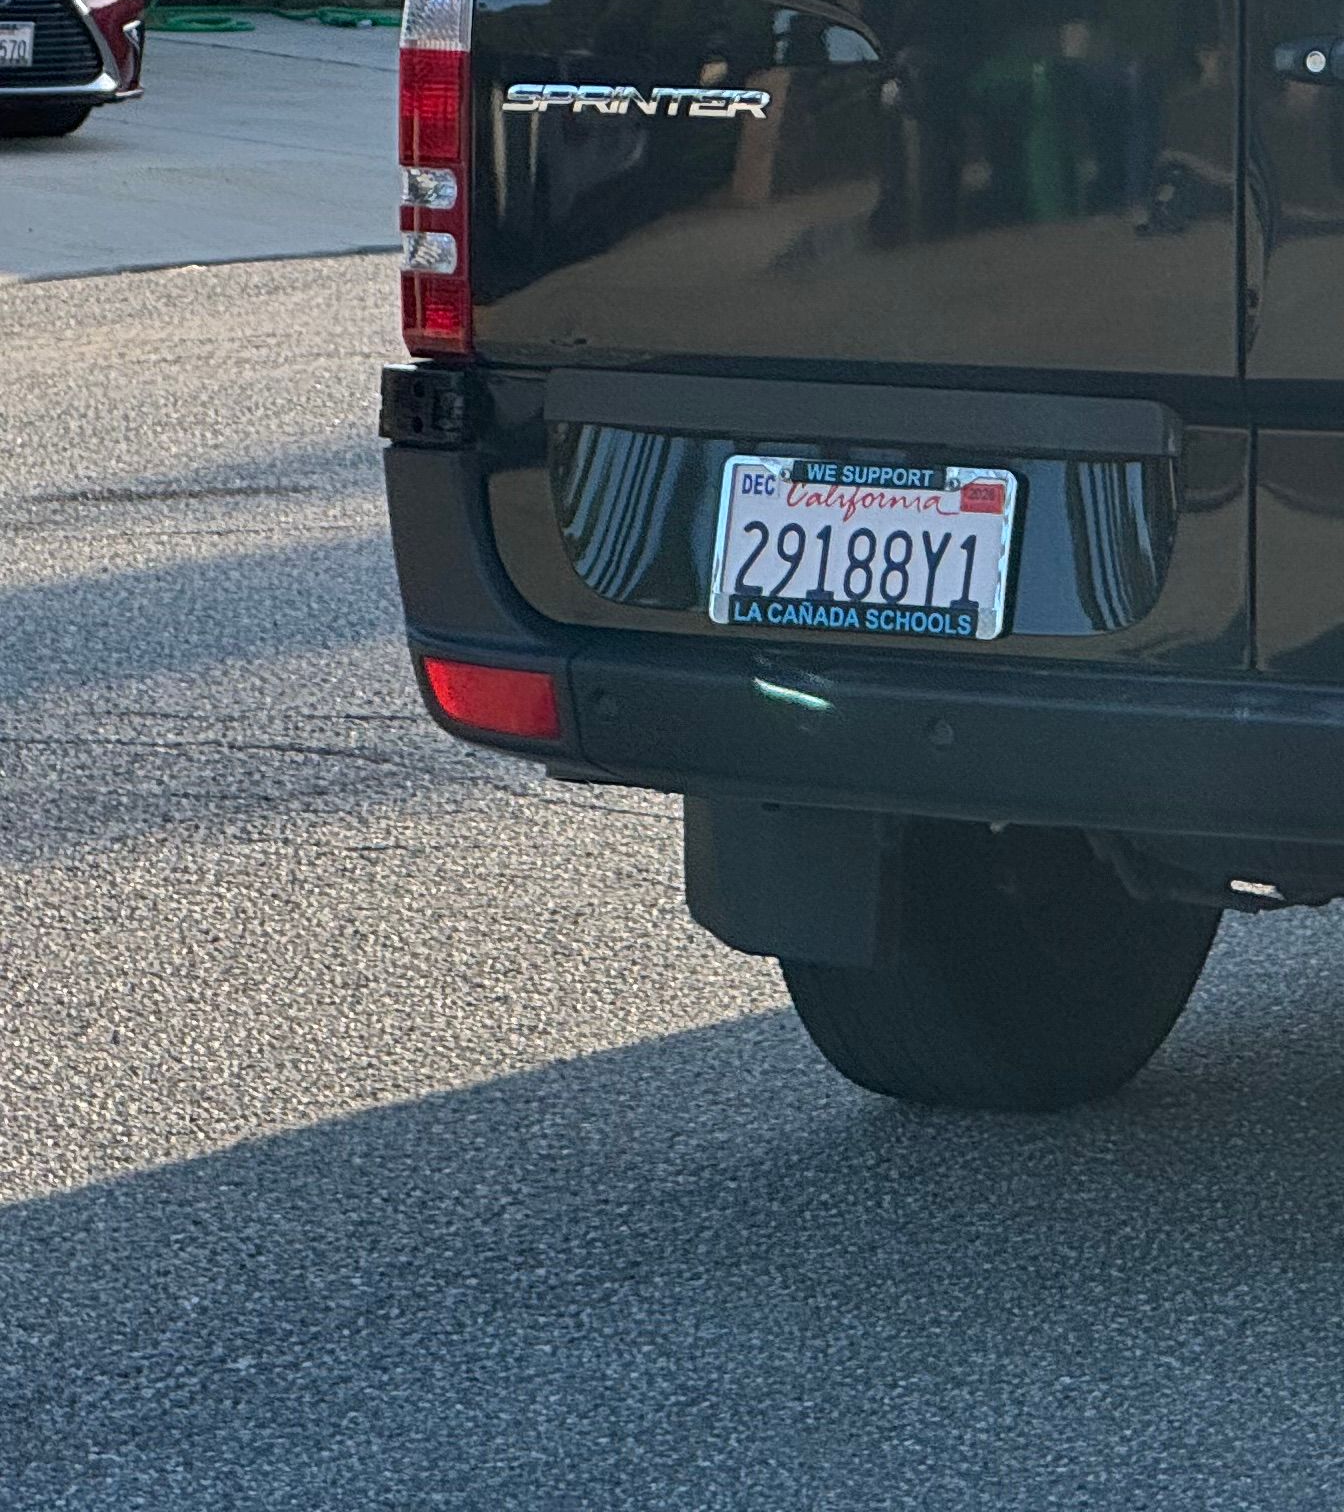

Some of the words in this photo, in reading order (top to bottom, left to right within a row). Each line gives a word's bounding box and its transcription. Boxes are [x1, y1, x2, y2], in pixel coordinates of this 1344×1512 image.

[502, 83, 770, 119] SPRINTER
[742, 473, 776, 496] DEC
[807, 464, 837, 481] WE
[842, 465, 934, 487] SUPPORT
[786, 482, 960, 522] California
[735, 521, 979, 609] 29188Y1
[734, 601, 763, 623] LA
[767, 602, 860, 628] CAÑADA
[865, 609, 972, 636] SCHOOLS
